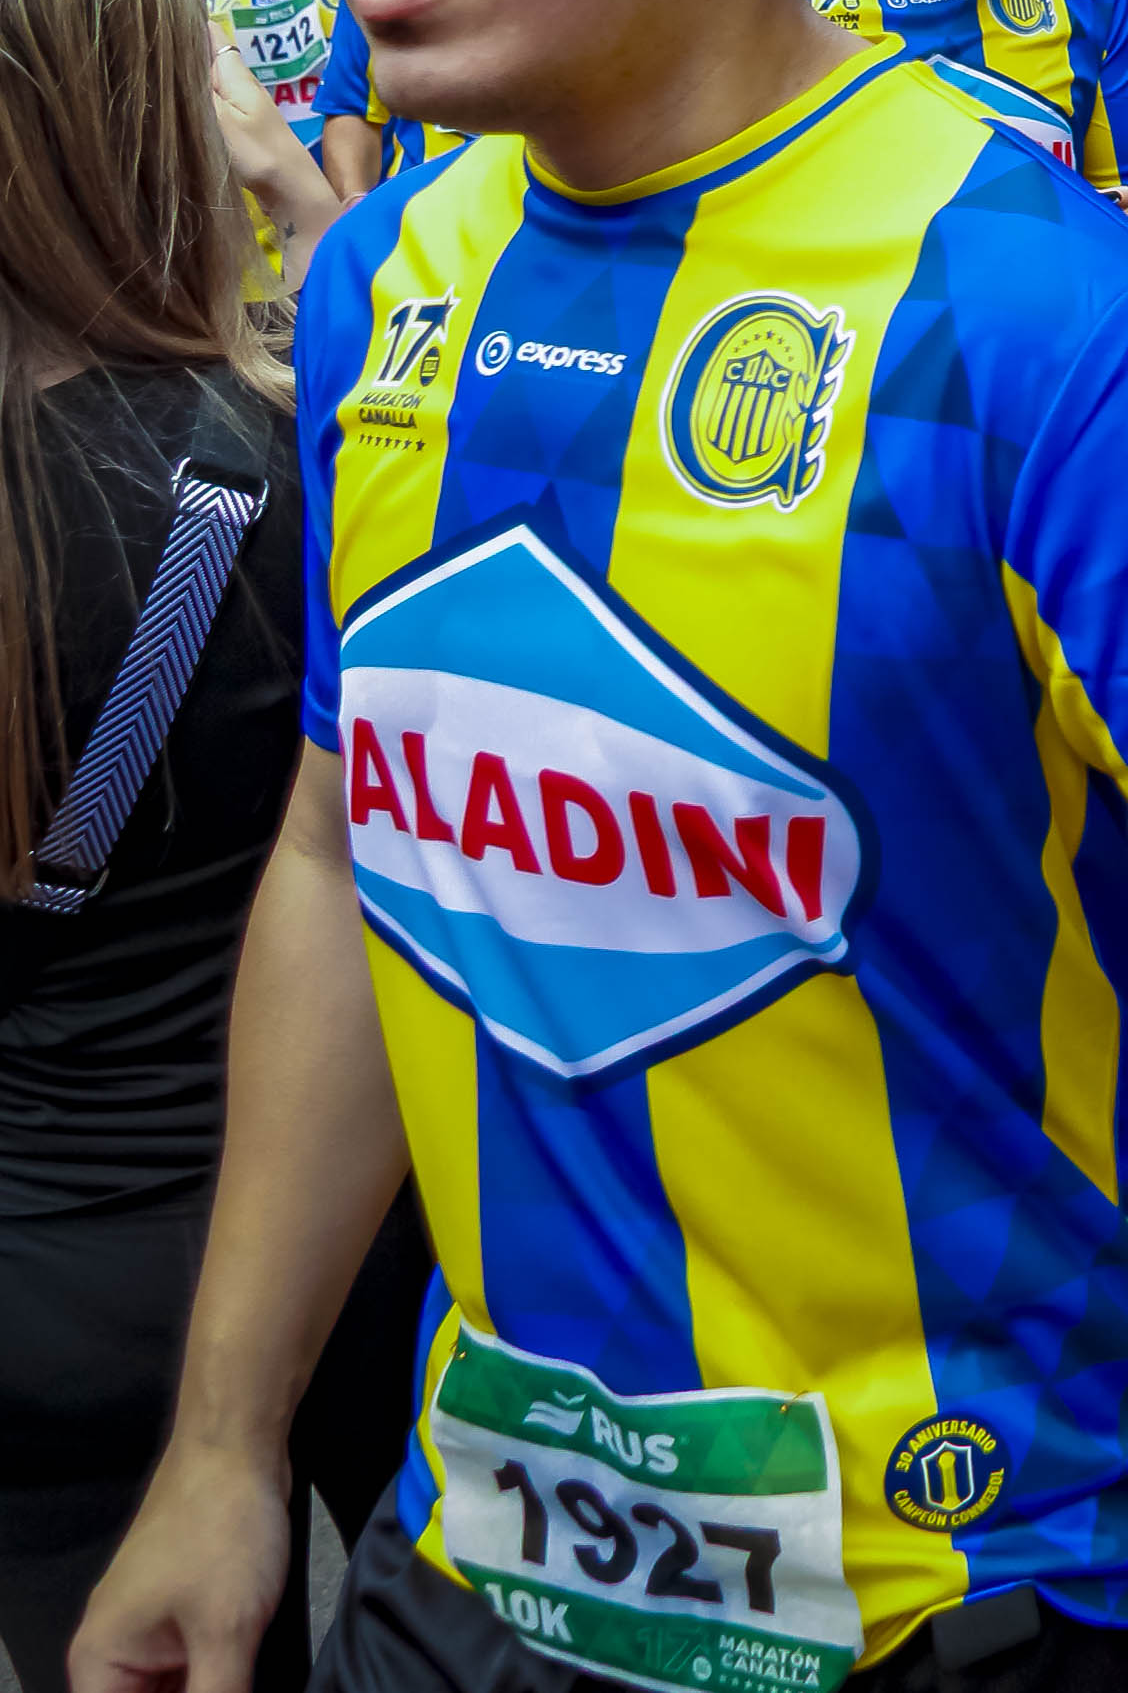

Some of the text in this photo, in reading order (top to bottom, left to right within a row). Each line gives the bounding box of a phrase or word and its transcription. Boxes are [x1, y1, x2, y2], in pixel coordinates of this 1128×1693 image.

[250, 16, 314, 63] 1212
[376, 296, 454, 381] 17
[516, 341, 628, 376] express
[359, 390, 426, 409] MARATÓN
[359, 407, 418, 430] CANALLA
[350, 717, 826, 923] ALADINI
[590, 1405, 679, 1475] RUS
[895, 1420, 997, 1473] 30 ANIVERSARIO
[894, 1489, 948, 1526] CAMPEÓN
[493, 1459, 781, 1615] 1927
[485, 1582, 573, 1643] 10K
[719, 1634, 820, 1671] MARATÓN
[720, 1652, 819, 1687] CANALLA
